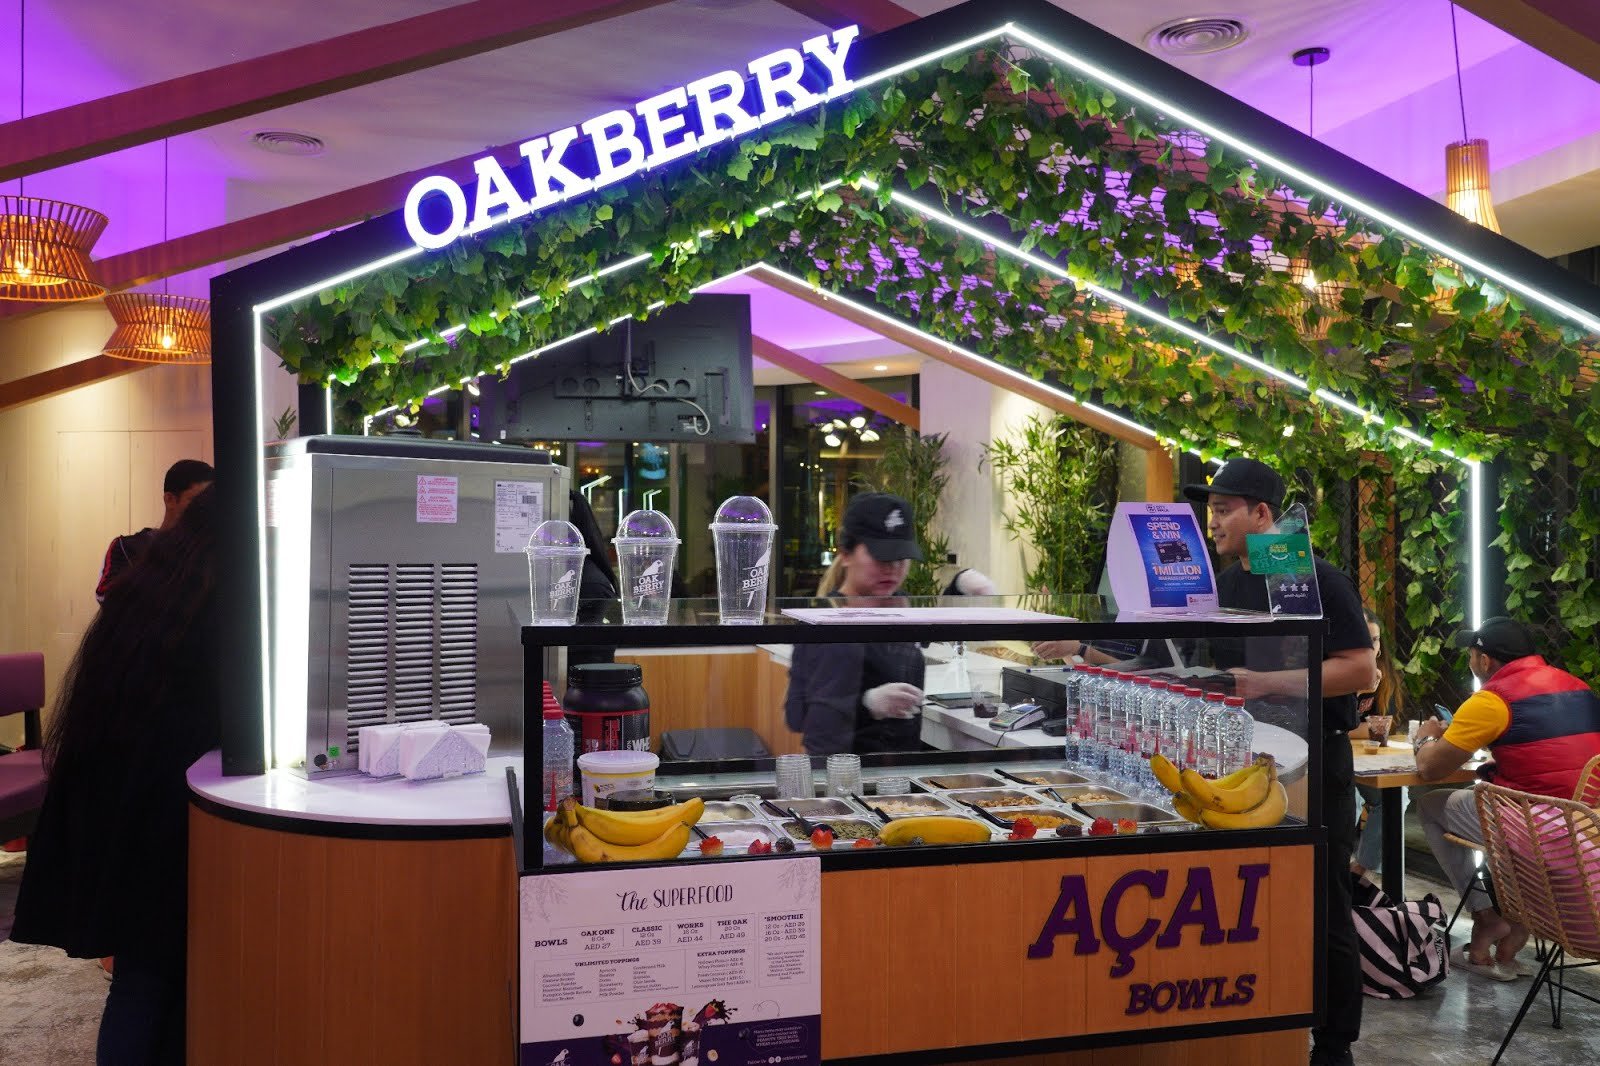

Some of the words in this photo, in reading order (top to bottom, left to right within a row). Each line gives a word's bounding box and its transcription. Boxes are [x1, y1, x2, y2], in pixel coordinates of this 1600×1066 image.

[404, 24, 859, 250] OAKBERRY
[1146, 522, 1181, 531] SPEND
[1152, 531, 1160, 539] &
[1160, 530, 1181, 539] WIN
[638, 574, 659, 585] OAK
[554, 581, 571, 590] OAK
[633, 580, 664, 594] BERRY
[616, 890, 649, 911] The
[653, 884, 733, 909] SUPERFOOD
[677, 922, 704, 930] WORKS
[1027, 864, 1271, 979] AÇAI
[598, 928, 615, 936] ONE
[631, 925, 663, 933] CLASSIC
[534, 938, 568, 948] BOWLS
[1125, 974, 1257, 1016] BOWLS
